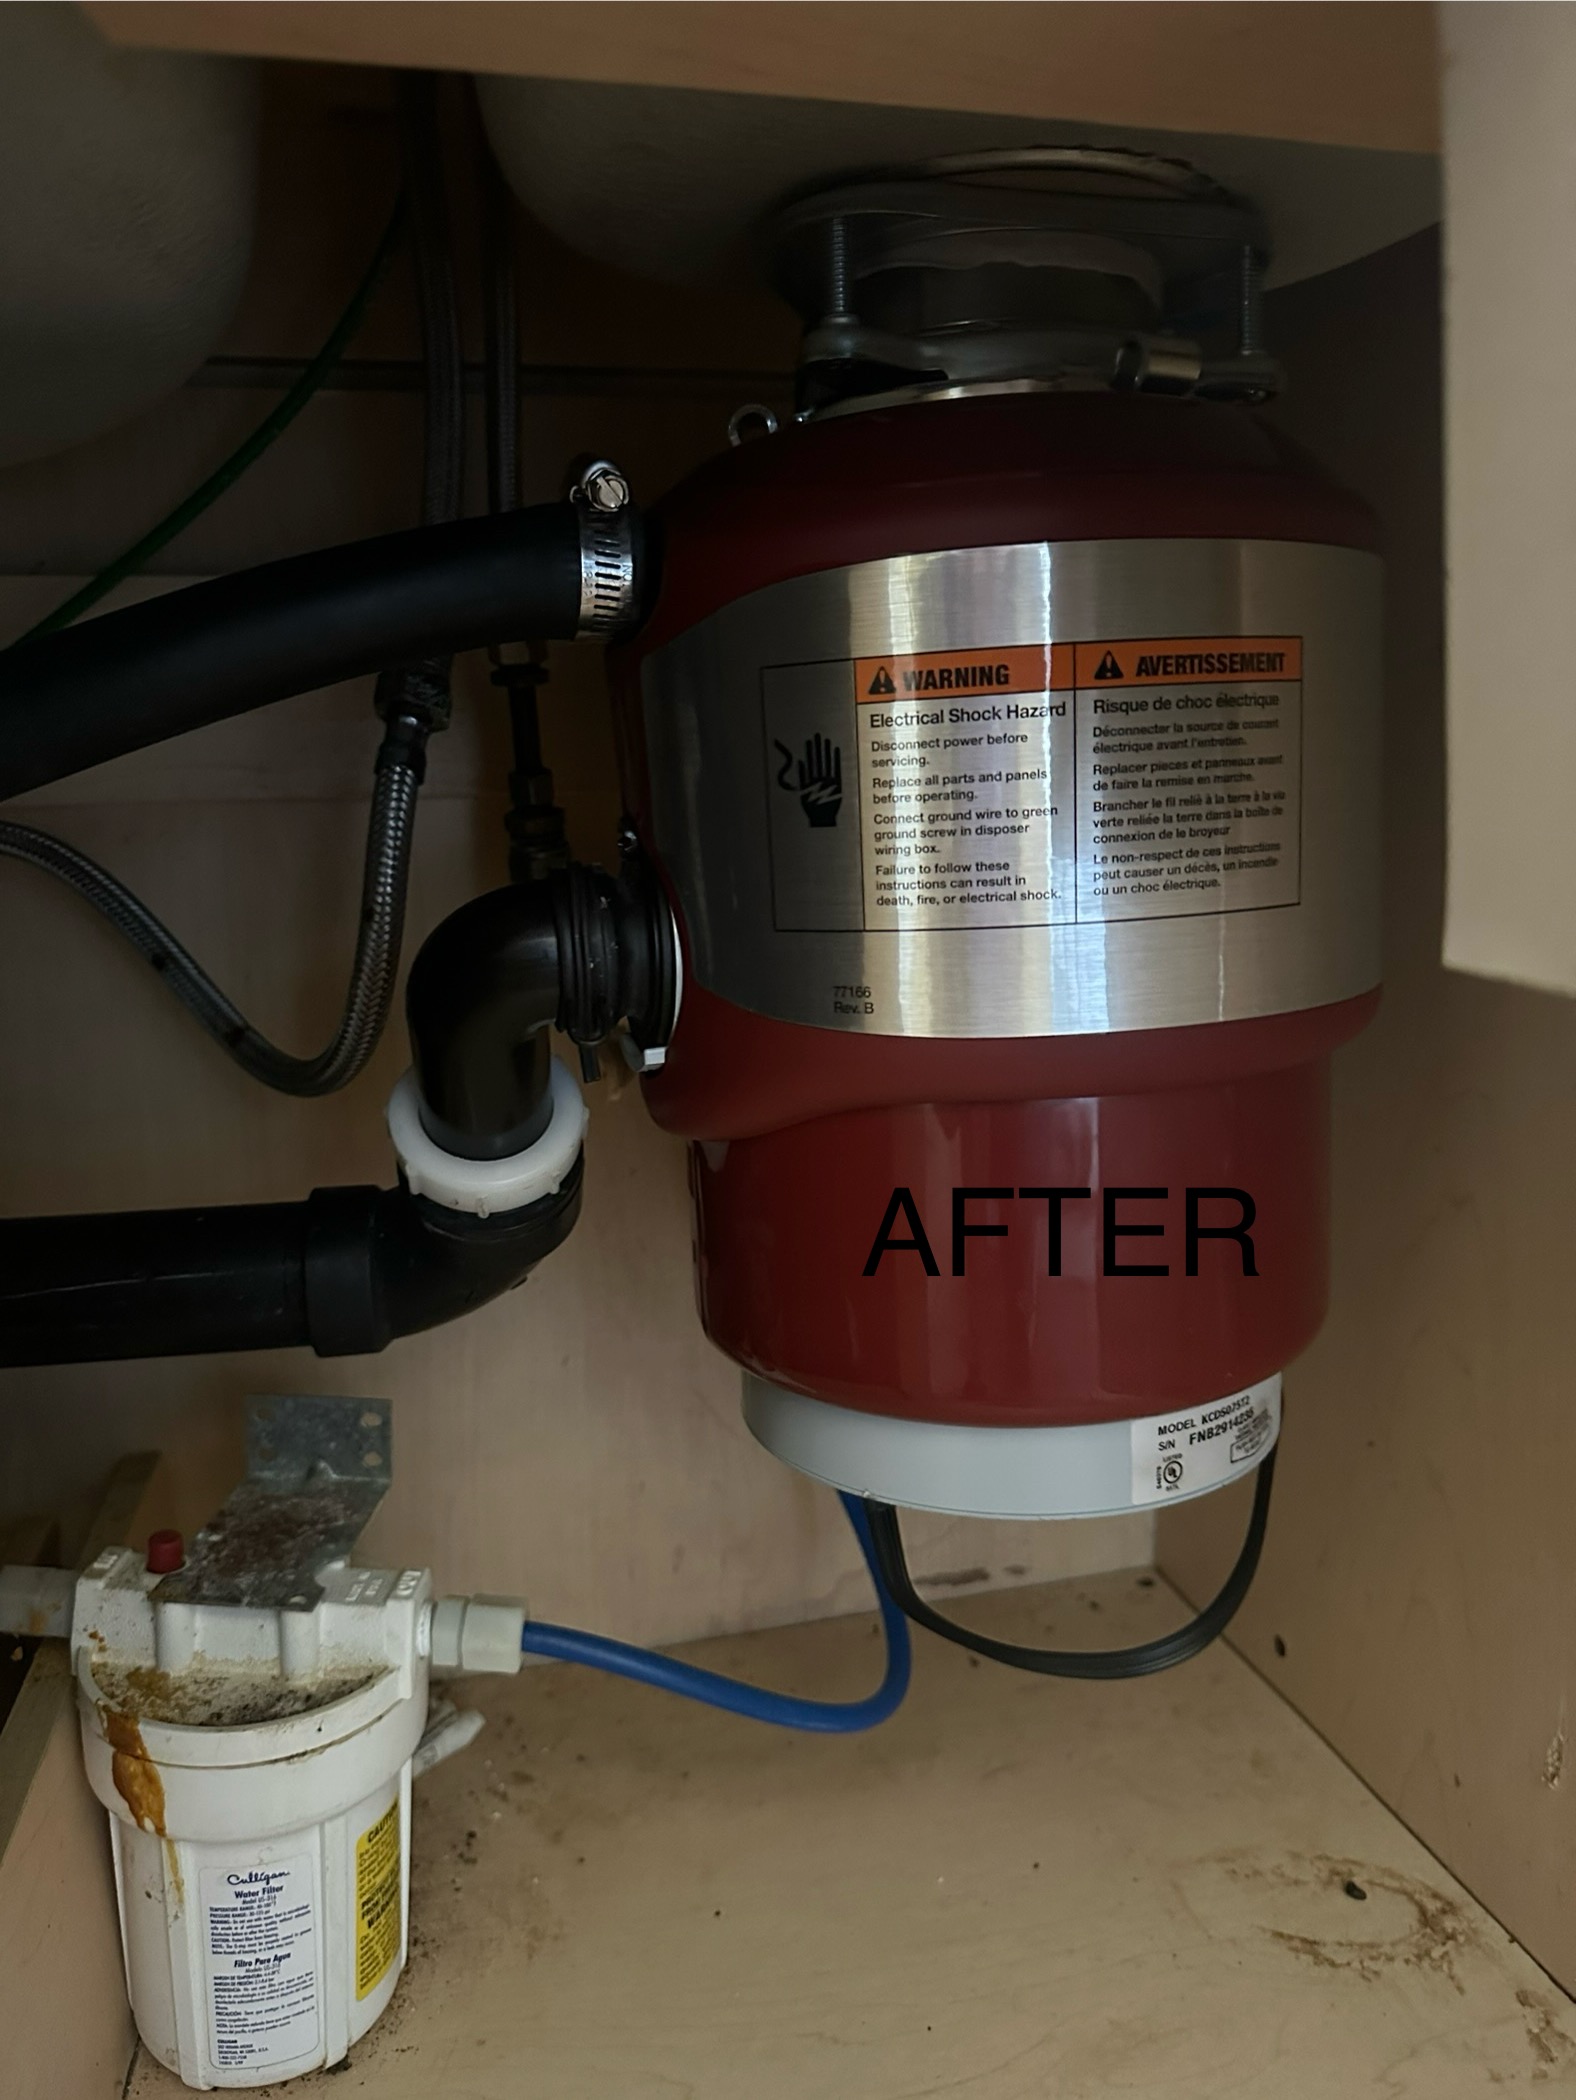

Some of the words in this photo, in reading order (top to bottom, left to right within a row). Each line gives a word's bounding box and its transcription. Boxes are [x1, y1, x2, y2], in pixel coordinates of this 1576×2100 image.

[1136, 653, 1285, 677] AVERTISSEMENT
[903, 664, 1009, 690] WARNING
[1093, 698, 1149, 715] Risque
[1153, 696, 1172, 710] de
[1176, 695, 1212, 710] choc
[1216, 692, 1279, 710] électrique
[870, 710, 944, 728] Electrical
[949, 706, 1002, 723] Shock
[1007, 702, 1066, 719] Hazard
[1093, 724, 1169, 737] Déconnecter
[1173, 723, 1183, 733] la
[1187, 722, 1223, 733] source
[1227, 721, 1239, 730] de
[1243, 719, 1279, 729] courant
[872, 738, 940, 752] Disconnect
[944, 736, 983, 749] power
[987, 733, 1028, 745] before
[1093, 741, 1153, 753] électrique
[1157, 739, 1188, 750] avant
[872, 756, 929, 768] servicing.
[1093, 763, 1147, 776] Replacer
[1191, 759, 1202, 769] et
[1205, 758, 1255, 772] panneaux
[873, 777, 921, 789] Replace
[925, 775, 938, 786] all
[943, 773, 975, 786] parts
[979, 771, 1002, 782] and
[1006, 769, 1047, 782] panels
[1093, 781, 1108, 791] de
[1112, 778, 1138, 789] faire
[1142, 777, 1152, 787] la
[1156, 775, 1193, 787] remise
[1198, 775, 1211, 784] en
[1214, 772, 1254, 783] marche.
[873, 793, 911, 804] before
[915, 789, 978, 803] operating.
[1093, 798, 1149, 812] Brancher
[1152, 798, 1162, 808] le
[1165, 797, 1175, 807] fil
[1206, 793, 1211, 805] à
[1215, 794, 1224, 804] la
[1228, 793, 1250, 803] terre
[1254, 791, 1260, 801] à
[874, 814, 924, 824] Connect
[928, 809, 971, 823] ground
[976, 808, 1002, 819] wire
[1006, 808, 1018, 818] to
[1022, 806, 1057, 818] green
[1093, 817, 1124, 828] verte
[1127, 813, 1159, 825] reliée
[1163, 813, 1173, 823] la
[1176, 812, 1203, 822] terre
[1206, 810, 1232, 820] dans
[1234, 808, 1243, 818] la
[1272, 806, 1282, 815] de
[874, 827, 916, 841] ground
[920, 827, 956, 837] screw
[961, 826, 971, 836] in
[976, 824, 1029, 837] disposer
[1093, 829, 1155, 844] connexion
[1159, 829, 1173, 839] de
[1176, 828, 1186, 838] le
[1189, 825, 1231, 839] broyeur
[875, 844, 910, 856] wiring
[915, 843, 940, 854] box.
[1094, 853, 1108, 864] Le
[1112, 848, 1182, 864] non-respect
[1186, 848, 1199, 858] de
[1203, 847, 1221, 856] ces
[1225, 842, 1280, 855] instructions
[876, 864, 915, 875] Failure
[919, 864, 931, 874] to
[935, 862, 971, 873] follow
[976, 861, 1009, 871] these
[1093, 868, 1121, 881] peut
[1124, 866, 1163, 878] causer
[1167, 865, 1181, 875] un
[1184, 862, 1220, 874] décès,
[1223, 861, 1236, 870] un
[876, 878, 947, 890] instructions
[950, 878, 972, 887] can
[976, 876, 1011, 887] result
[1015, 875, 1026, 885] in
[1093, 885, 1108, 896] ou
[1112, 885, 1127, 894] un
[1131, 881, 1159, 892] choc
[1163, 878, 1220, 890] électrique.
[877, 894, 913, 906] death,
[917, 893, 940, 905] fire,
[943, 892, 956, 903] or
[960, 890, 1017, 903] electrical
[1020, 889, 1061, 901] shock.
[834, 1002, 861, 1014] Rev.
[865, 1002, 874, 1014] B
[1158, 1419, 1196, 1436] MODEL
[1159, 1439, 1175, 1451] S/N
[227, 1871, 290, 1885] Culligan
[234, 1890, 260, 1899] Water
[262, 1885, 284, 1895] Filter
[234, 1960, 253, 1968] Filtro
[254, 1957, 271, 1966] Para
[273, 1953, 291, 1962] Agua
